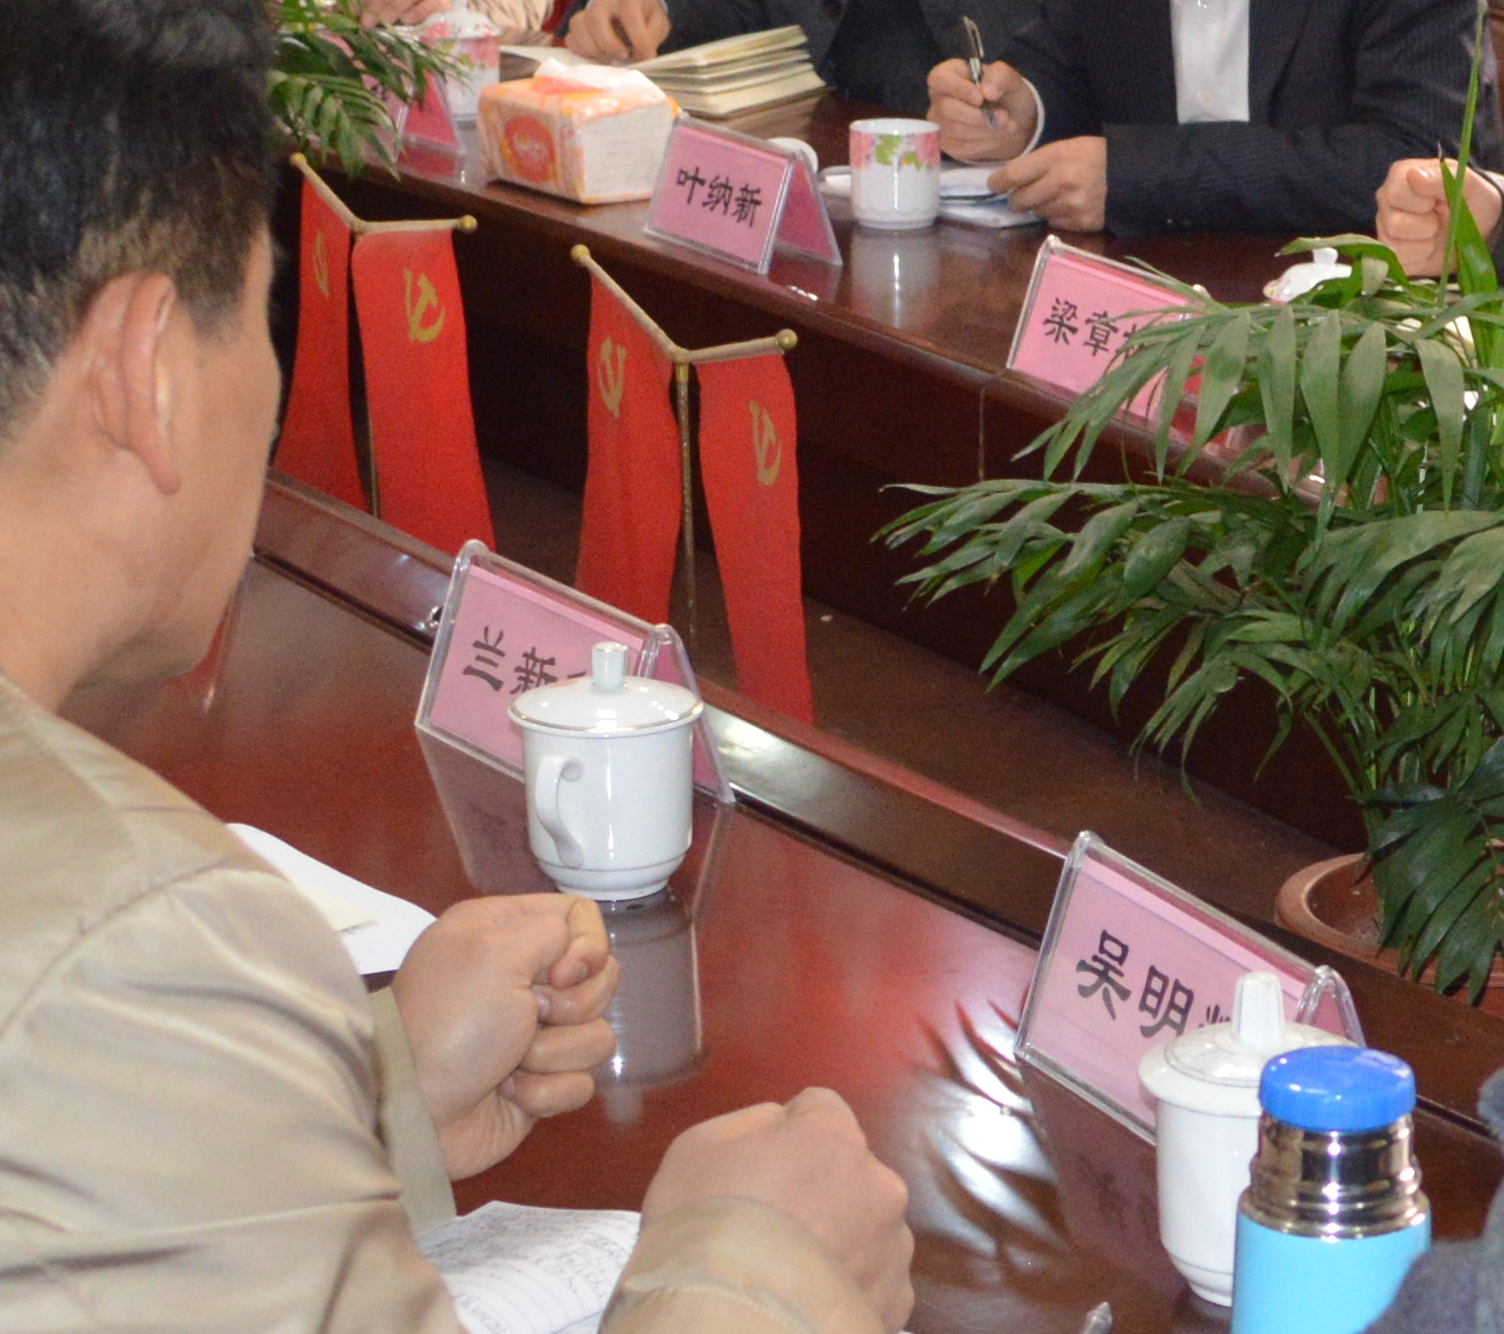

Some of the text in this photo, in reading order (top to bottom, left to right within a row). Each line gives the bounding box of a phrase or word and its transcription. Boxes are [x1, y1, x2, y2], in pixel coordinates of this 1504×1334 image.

[676, 166, 762, 228] 叶纳新
[463, 625, 587, 695] 兰新
[1076, 929, 1231, 1038] 吴明
